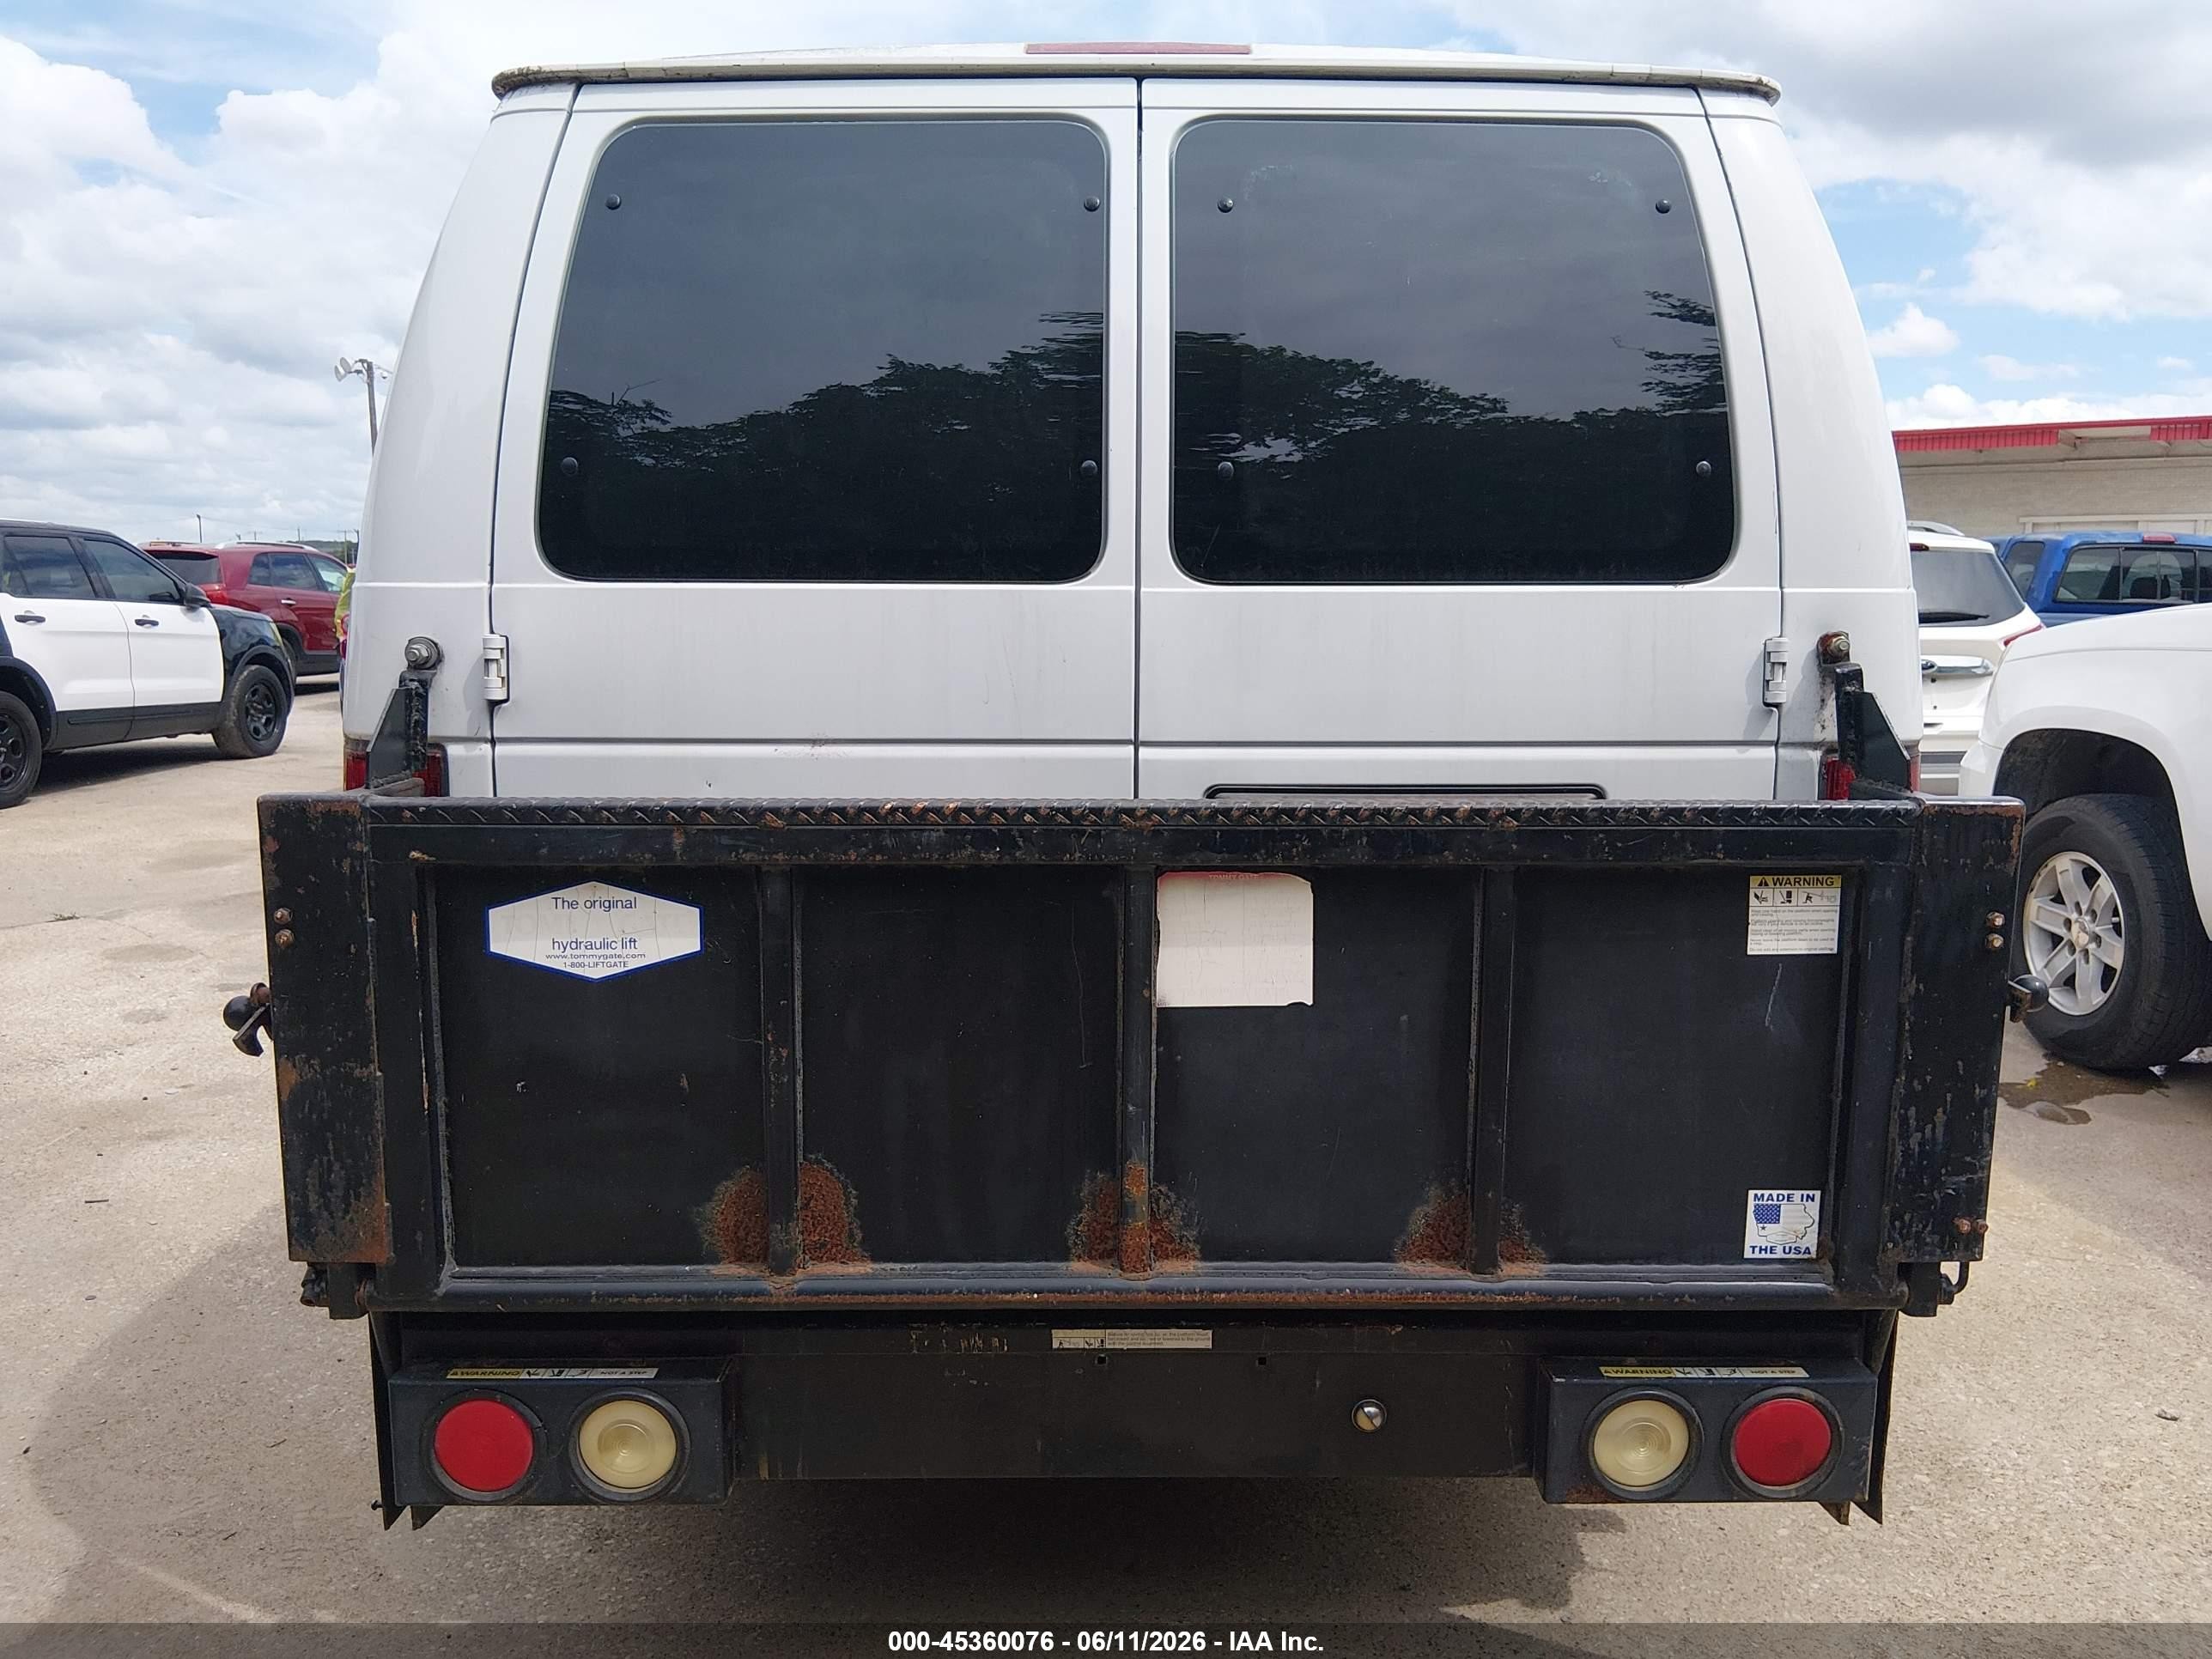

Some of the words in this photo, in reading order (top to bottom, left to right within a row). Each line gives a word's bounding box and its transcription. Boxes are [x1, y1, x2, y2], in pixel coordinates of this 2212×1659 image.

[1771, 877, 1835, 887] WARNING
[550, 896, 579, 910] The
[584, 896, 637, 913] original
[552, 937, 617, 954] hydraulic
[621, 937, 638, 950] lift
[1753, 1193, 1795, 1203] MADE
[1801, 1193, 1816, 1203] IN
[1750, 1245, 1778, 1255] THE
[1783, 1245, 1812, 1255] USA
